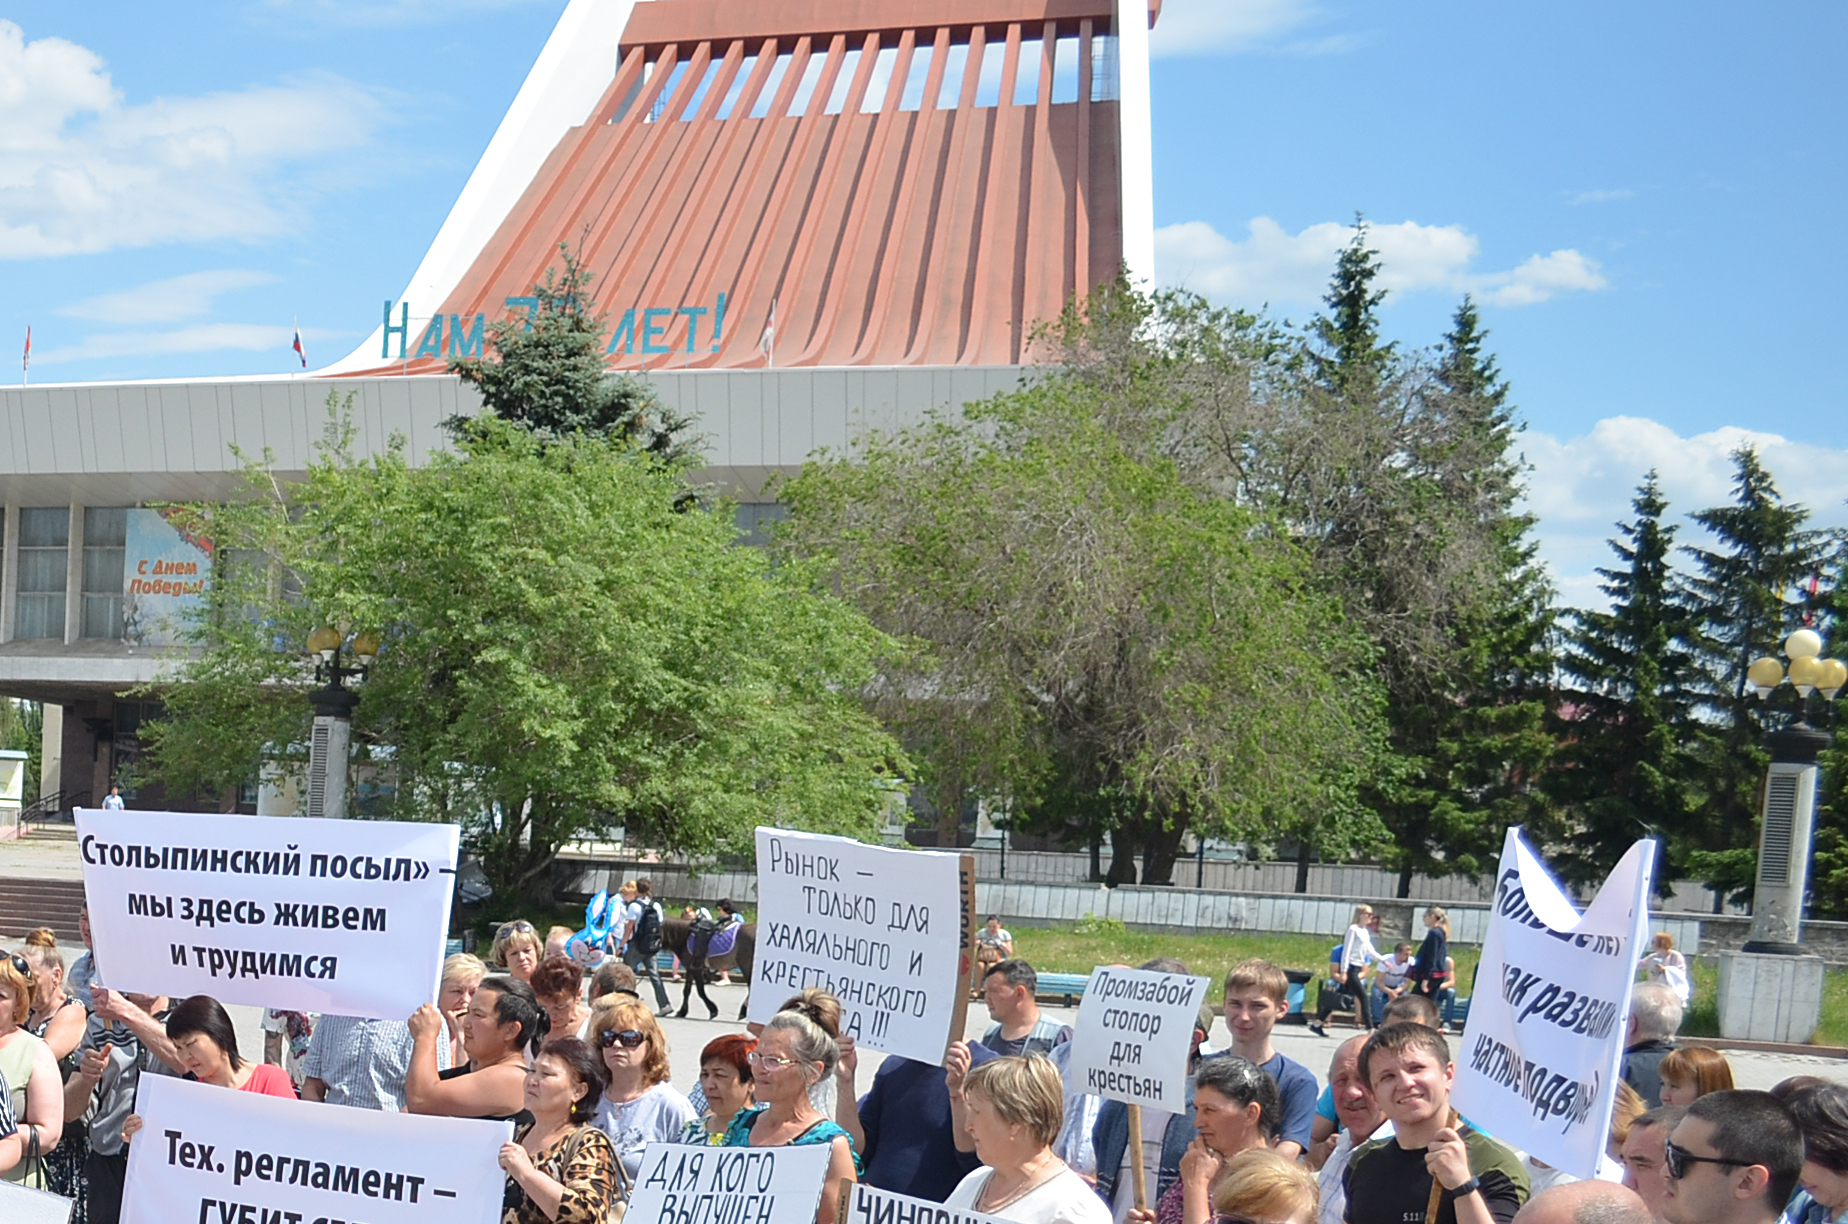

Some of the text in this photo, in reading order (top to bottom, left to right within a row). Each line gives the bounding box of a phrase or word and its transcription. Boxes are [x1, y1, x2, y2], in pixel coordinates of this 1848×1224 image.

[605, 292, 726, 354] ЛЕТ!
[137, 559, 198, 575] С Днем
[309, 852, 430, 882] посыл»
[128, 892, 387, 932] мы здесь живем
[802, 886, 930, 935] ТОЛЬКО ДЛЯ
[170, 943, 338, 980] и трудимся
[766, 921, 923, 976] ХАЛЯЛЬНОГО И
[1092, 971, 1196, 1007] Промзабой
[1102, 1007, 1161, 1041] стопор
[1109, 1041, 1142, 1067] для
[1088, 1067, 1163, 1101] крестьян
[164, 1129, 225, 1174] Тех.
[233, 1149, 425, 1204] регламент
[645, 1150, 775, 1193] ДЛЯ КОГО
